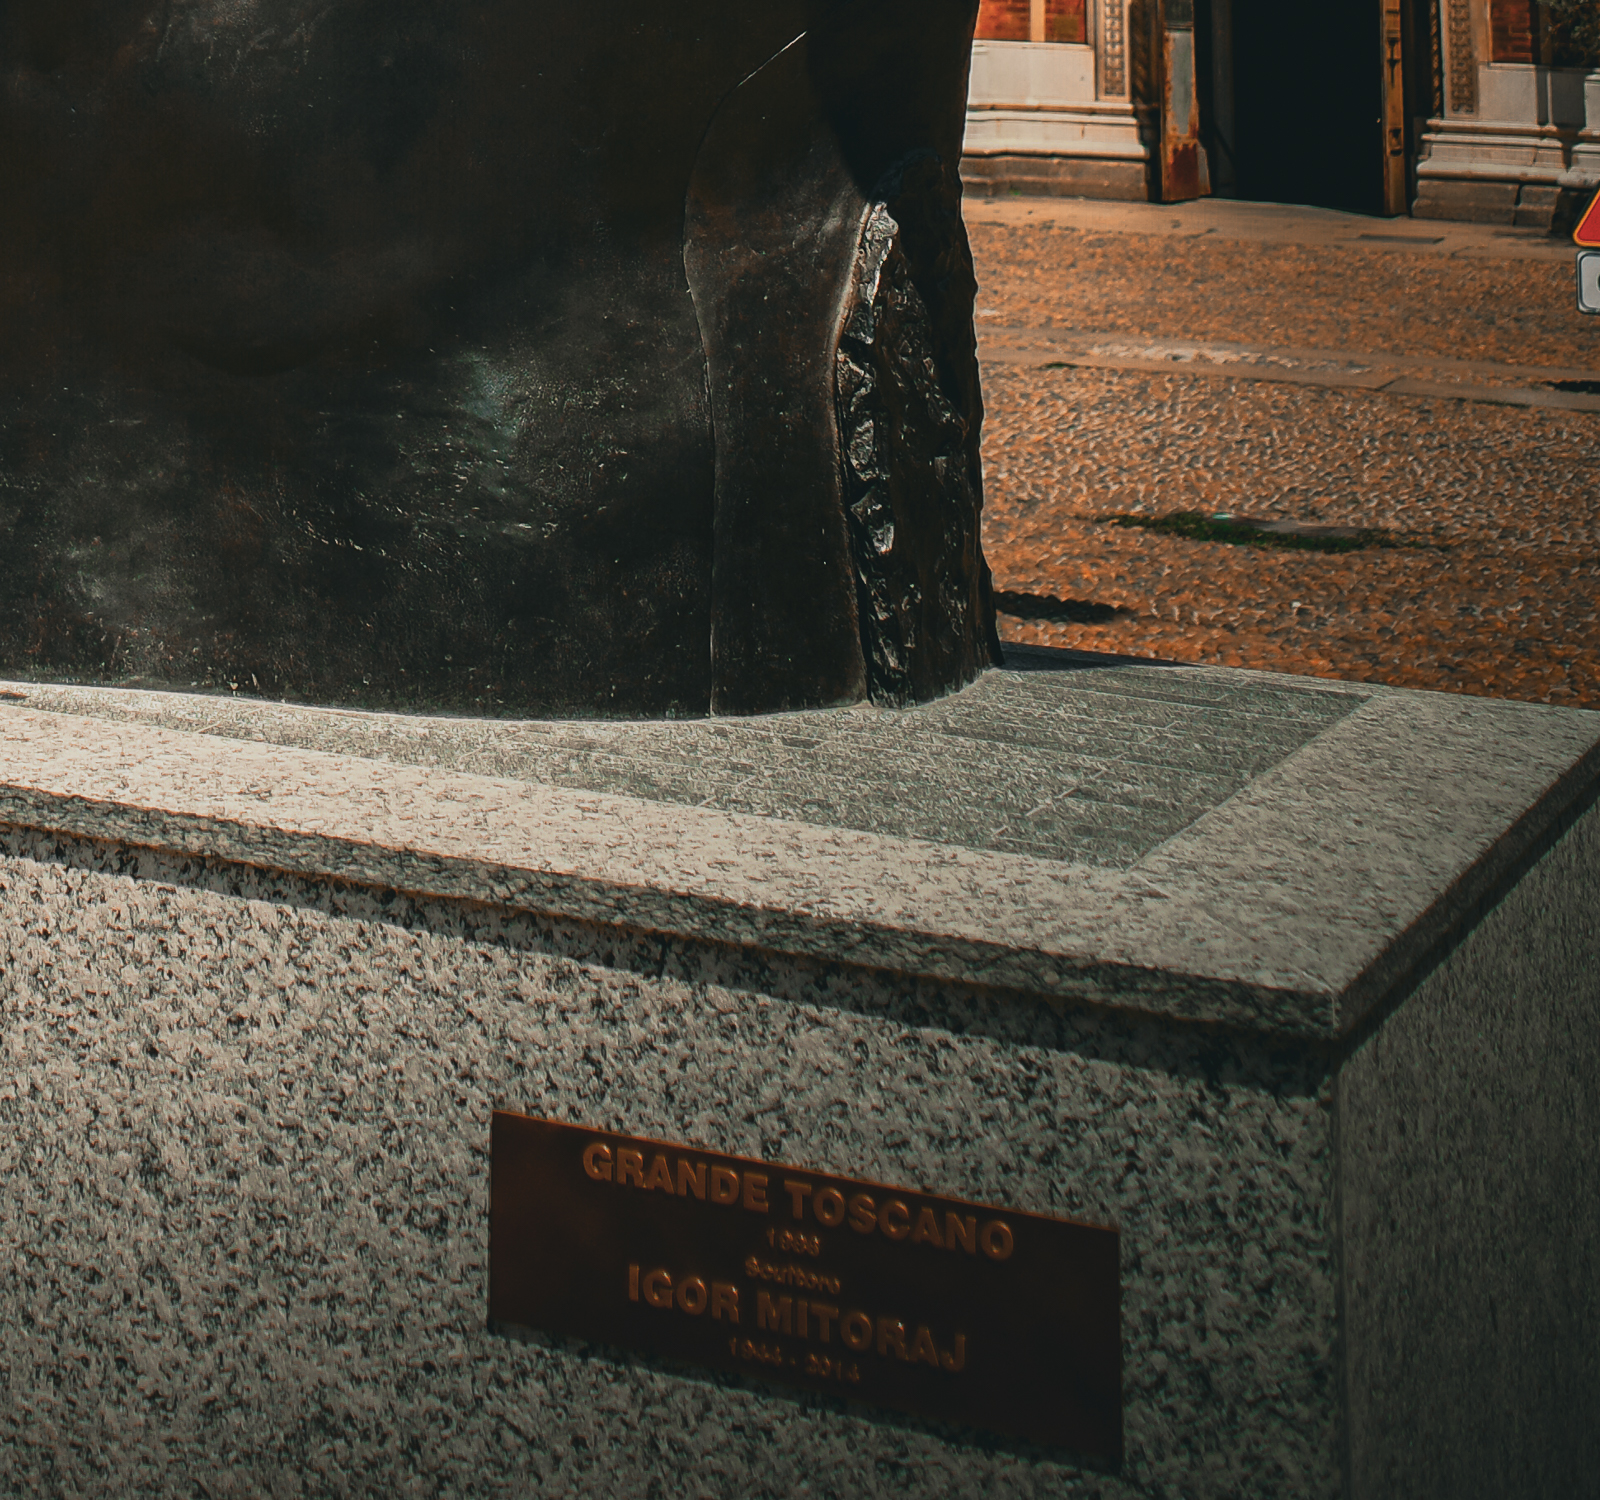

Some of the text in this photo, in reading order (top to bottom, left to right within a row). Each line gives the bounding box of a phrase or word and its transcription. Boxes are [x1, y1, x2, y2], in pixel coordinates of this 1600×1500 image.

[582, 1142, 1014, 1260] GRANDE TOSCANO
[627, 1262, 966, 1372] IGOR MITORAJ
